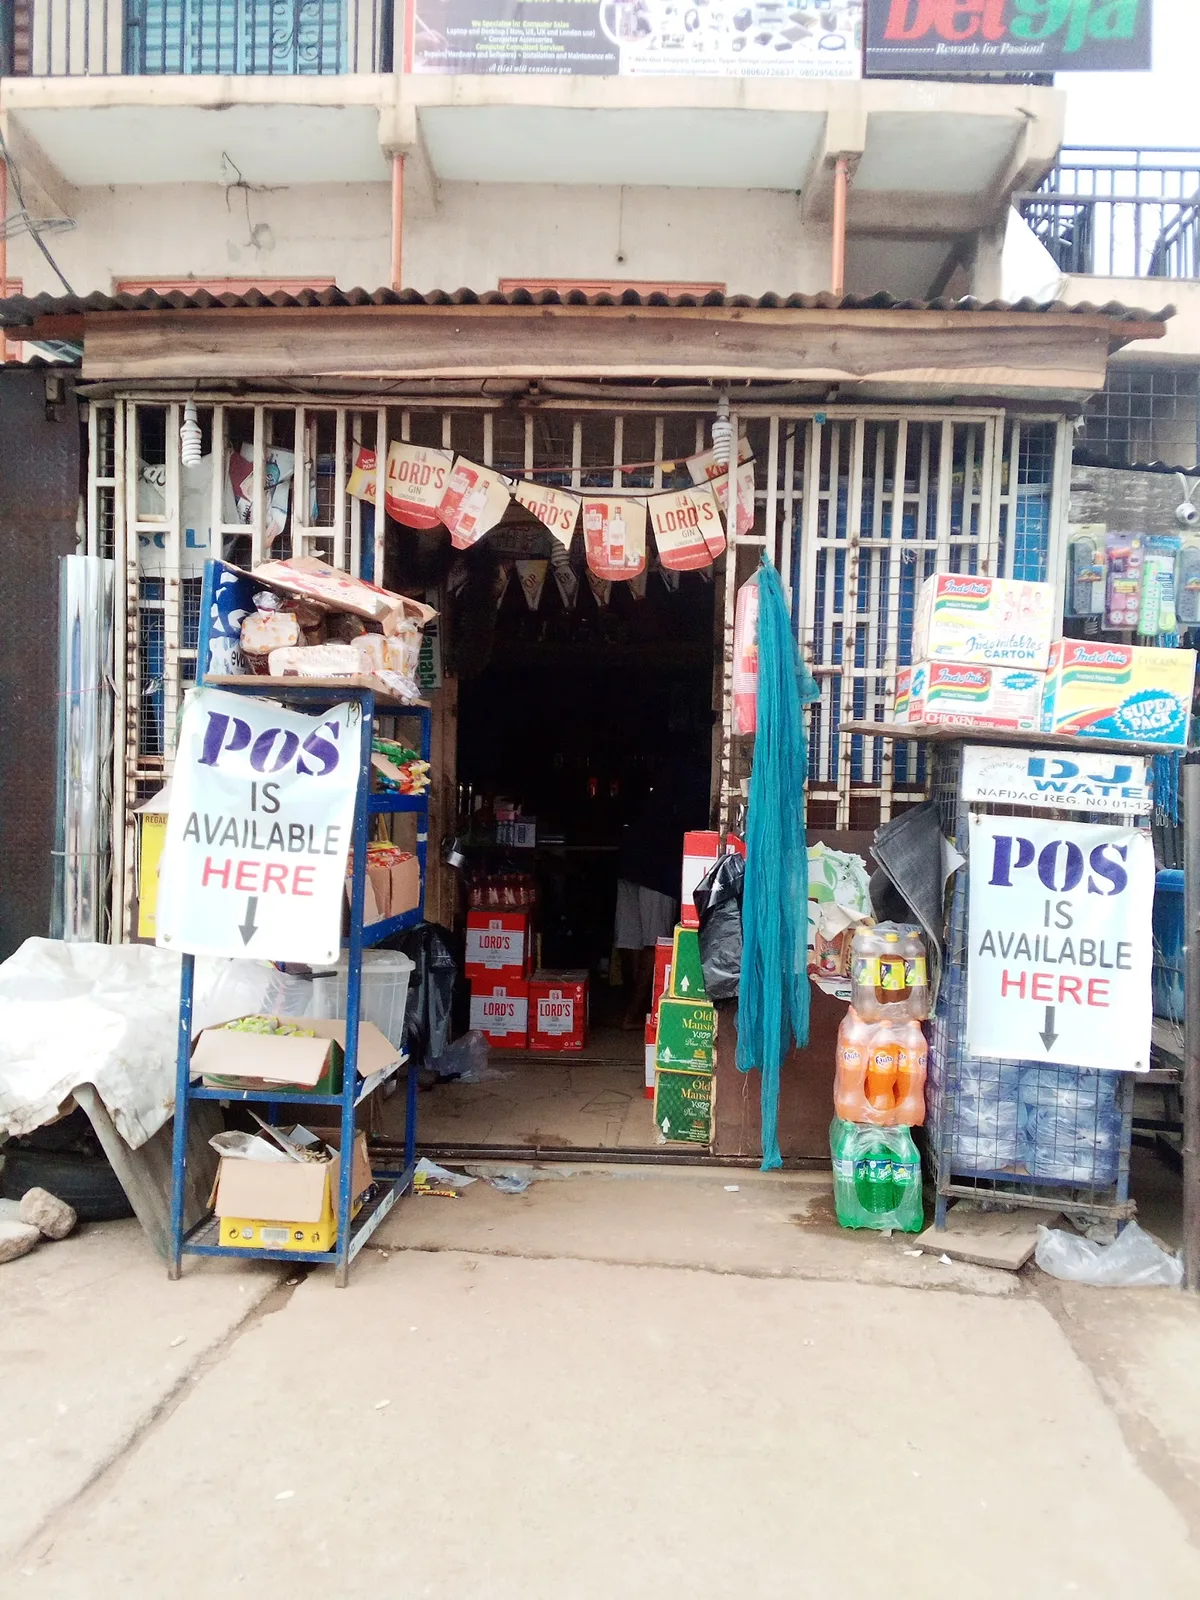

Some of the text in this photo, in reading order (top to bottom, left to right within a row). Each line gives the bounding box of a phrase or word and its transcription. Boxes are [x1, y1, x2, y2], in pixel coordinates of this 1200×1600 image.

[446, 28, 467, 36] Laptop
[481, 28, 505, 36] Desktop
[523, 21, 552, 29] Computer
[523, 51, 555, 60] Installation
[568, 52, 604, 60] Maintenance
[935, 42, 1044, 55] Rewards for Passion!
[389, 459, 446, 490] LORD'S
[408, 484, 422, 496] GIN
[656, 502, 714, 534] LORD'S
[681, 530, 696, 539] GIN
[943, 579, 988, 594] Indomie
[984, 650, 1035, 659] CARTON
[1074, 646, 1127, 664] Indomie
[939, 667, 986, 684] Indomie
[1121, 697, 1178, 720] SUPER
[926, 713, 974, 727] CHICKEN
[1130, 711, 1173, 731] PACK
[198, 711, 340, 777] POS
[1027, 757, 1154, 786] DJ
[251, 781, 281, 814] IS
[977, 788, 1039, 801] NAFDAC
[1044, 794, 1081, 804] REG.
[1086, 798, 1107, 807] NO
[1033, 779, 1154, 800] WATE
[145, 815, 167, 825] REGAL
[183, 812, 342, 856] AVAILABLE
[988, 835, 1129, 896] POS
[201, 856, 316, 897] HERE
[1044, 899, 1074, 930] IS
[479, 935, 511, 950] LORD'S
[979, 929, 1133, 970] AVAILABLE
[1001, 969, 1110, 1008] HERE
[483, 1002, 515, 1016] LORD'S
[540, 1003, 571, 1017] LORD'S
[693, 1010, 713, 1022] Old
[692, 1079, 711, 1091] Old
